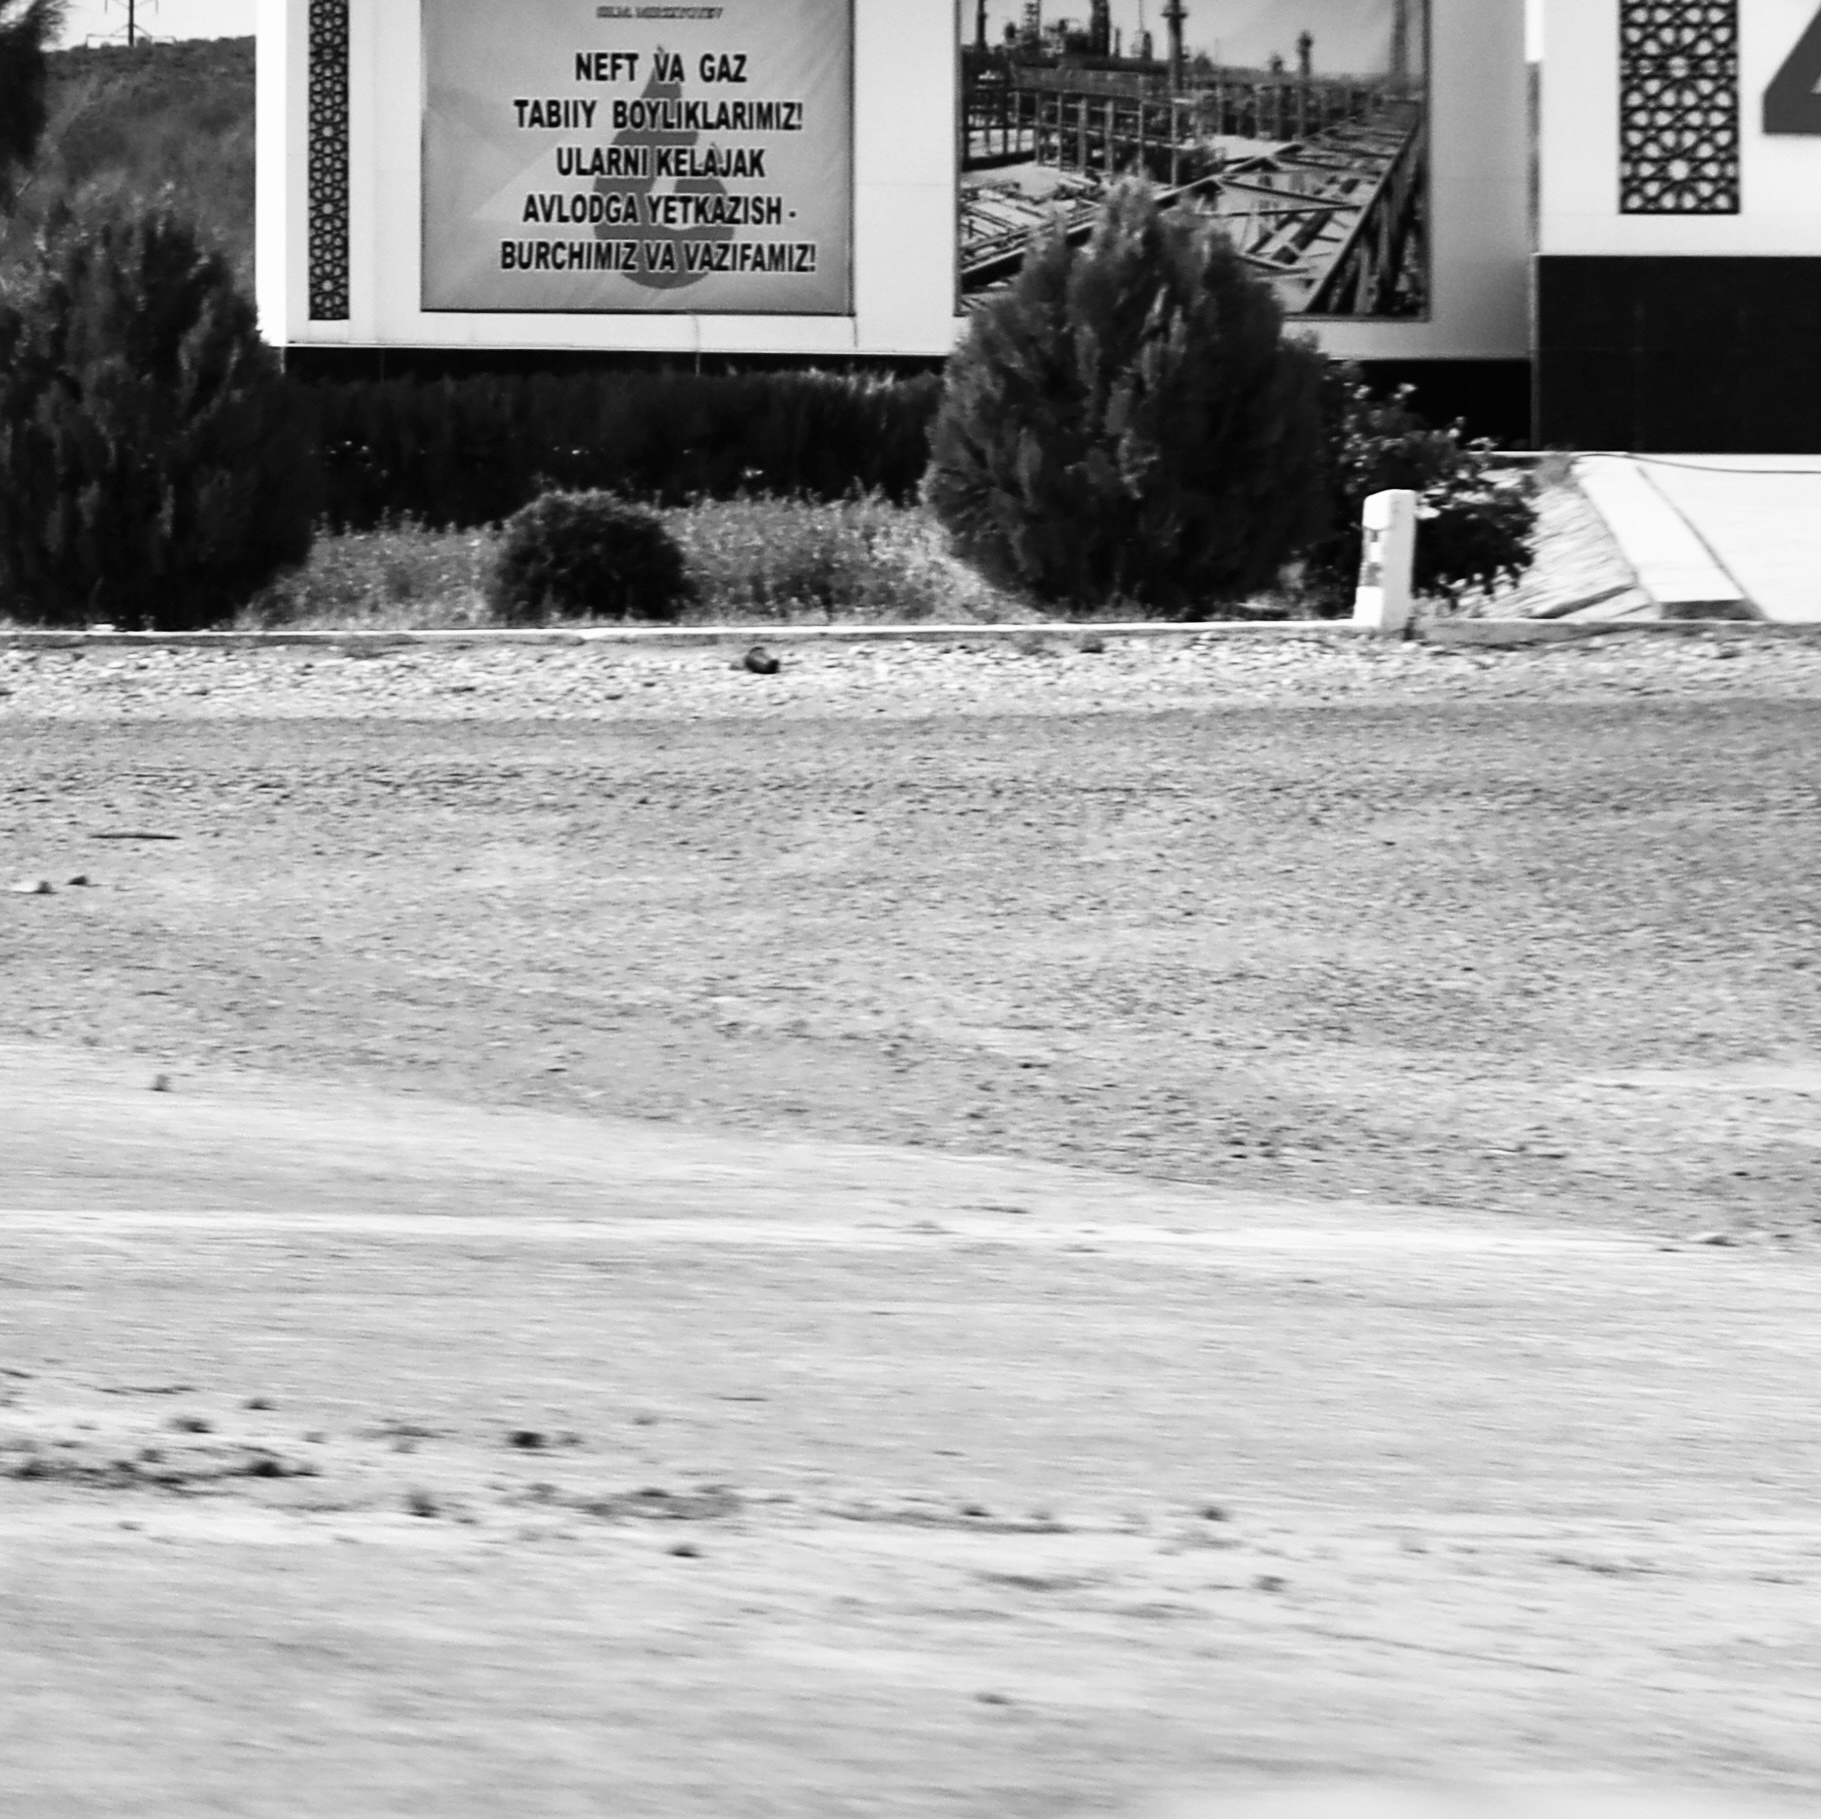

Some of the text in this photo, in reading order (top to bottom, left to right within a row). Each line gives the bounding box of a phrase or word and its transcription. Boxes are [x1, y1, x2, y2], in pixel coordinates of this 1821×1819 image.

[575, 52, 747, 83] NEFT VA GAZ
[513, 99, 803, 130] TABIIY BOYLIKLARIMIZ!
[557, 147, 765, 178] ULARNI KELAJAK
[522, 194, 639, 223] AVLODGA
[647, 195, 783, 225] YETKAZISH
[501, 241, 816, 272] BURCHIMIZ VA VAZIFAMIZ!
